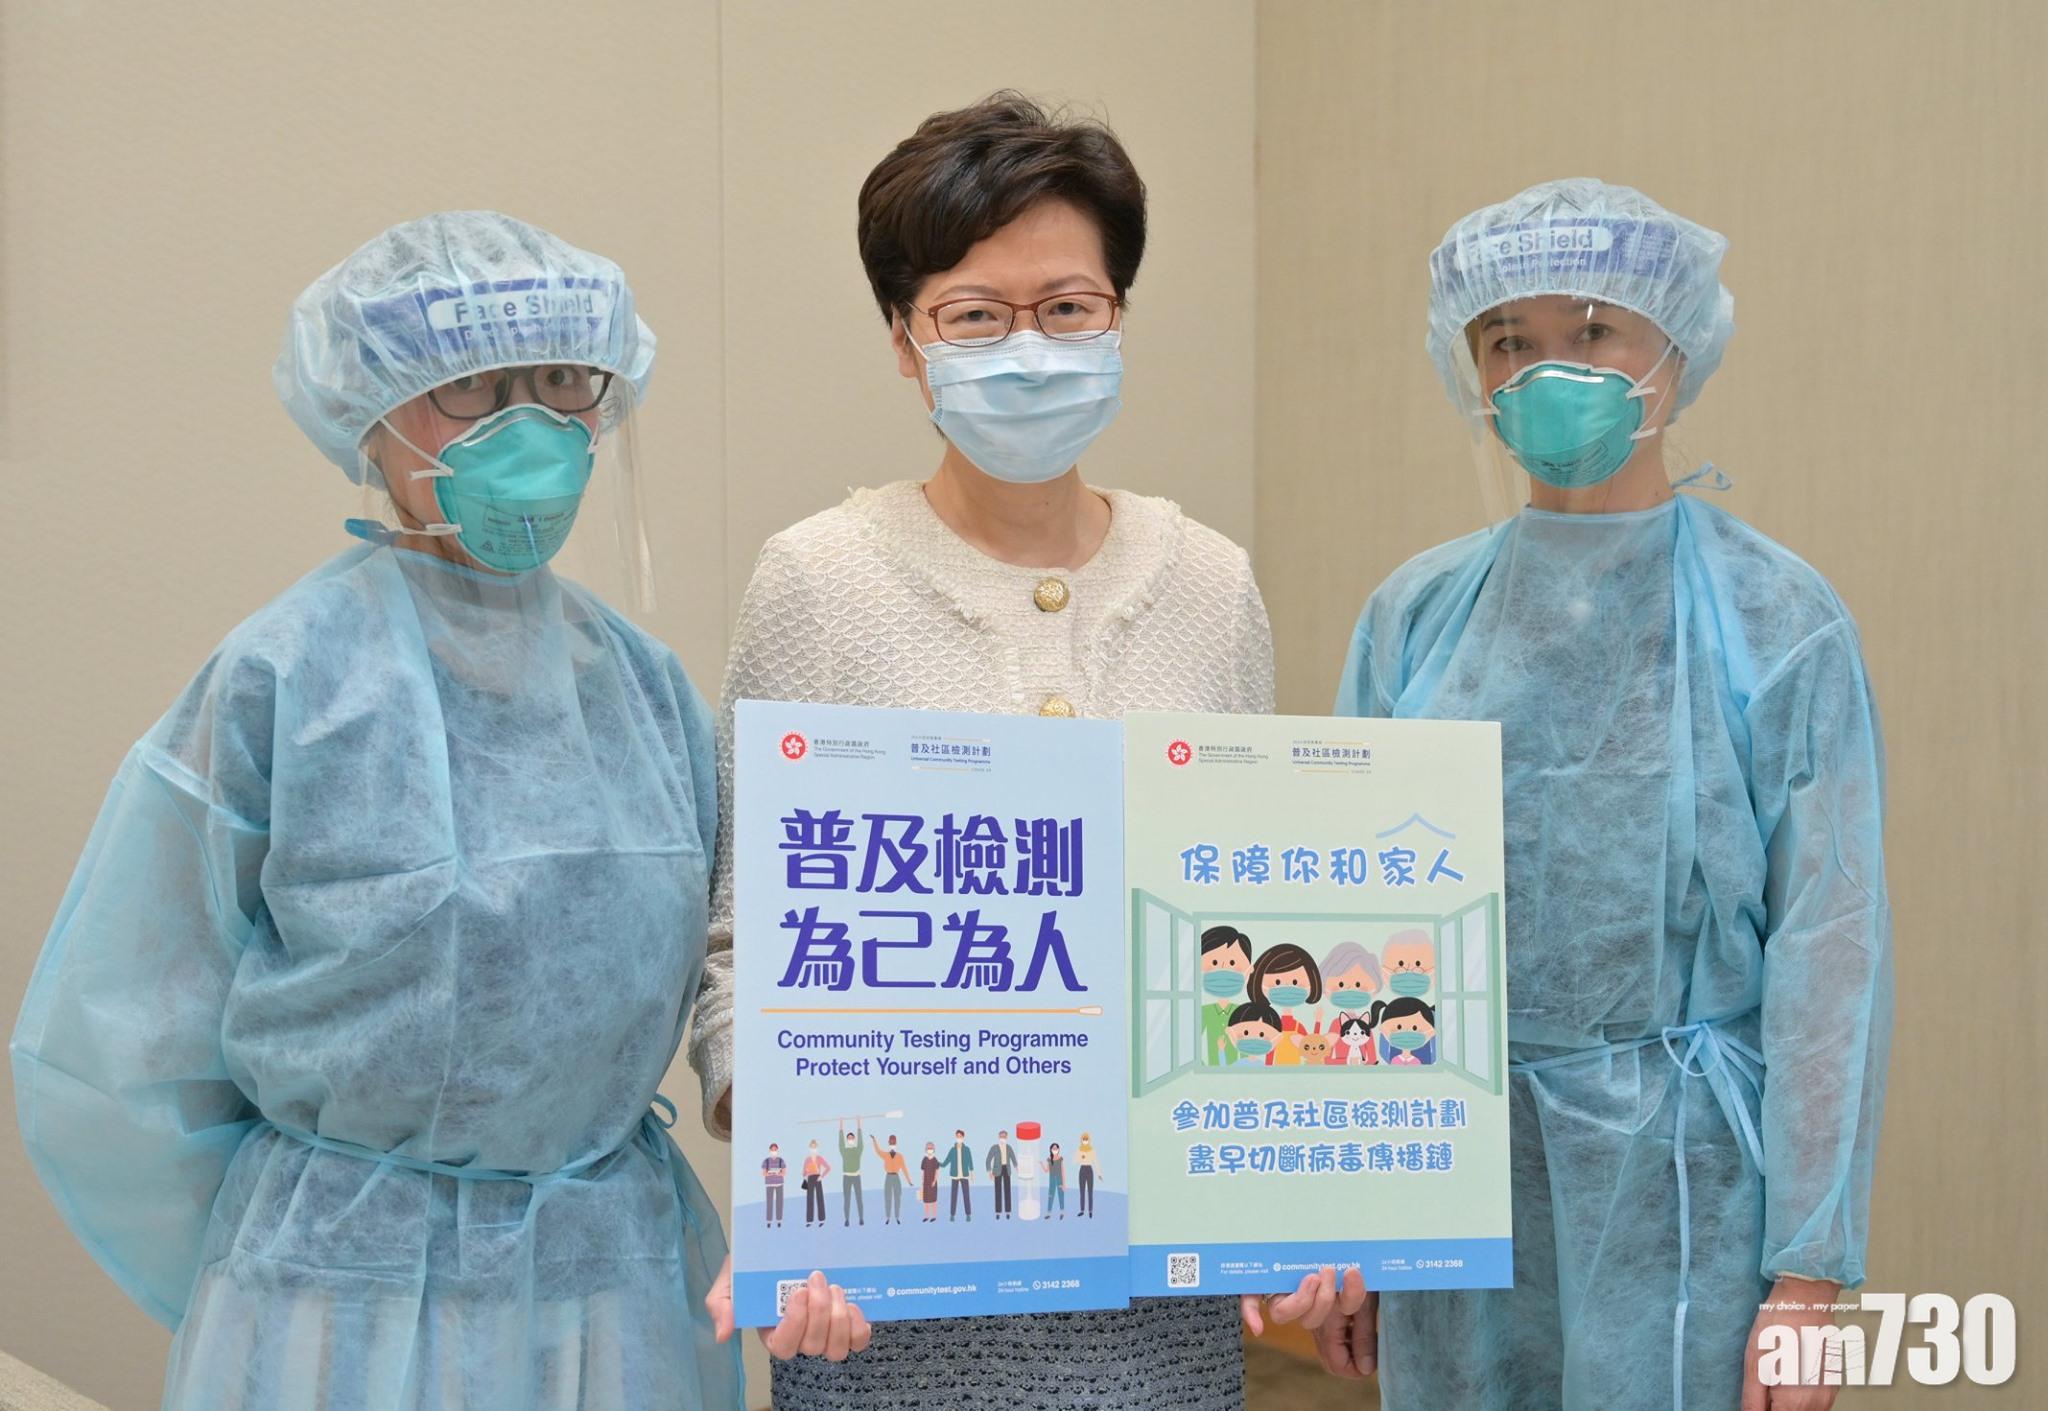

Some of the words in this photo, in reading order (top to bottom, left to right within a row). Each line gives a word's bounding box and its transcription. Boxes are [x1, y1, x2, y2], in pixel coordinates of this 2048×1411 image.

[911, 743, 991, 757] 普及社區檢測計劃
[1292, 747, 1370, 759] 普及社區檢測計劃
[778, 808, 1084, 897] 普及檢測
[1180, 843, 1465, 887] 保障你和家人
[777, 905, 1089, 992] 為己為人
[777, 1029, 895, 1053] Community
[900, 1029, 971, 1052] Testing
[978, 1029, 1089, 1052] Programme
[796, 1057, 870, 1076] Protect
[876, 1057, 957, 1075] Yourself
[963, 1056, 1000, 1075] and
[1006, 1056, 1072, 1075] Others
[1172, 1098, 1468, 1131] 參加普及社區檢測計劃
[1187, 1142, 1454, 1174] 盡早切斷病毒傳播鏈
[1425, 1260, 1443, 1269] 3142
[1445, 1259, 1463, 1268] 2368
[896, 1283, 977, 1295] communitytest.gov.hk
[1042, 1280, 1060, 1289] 3142
[1061, 1280, 1080, 1289] 2368
